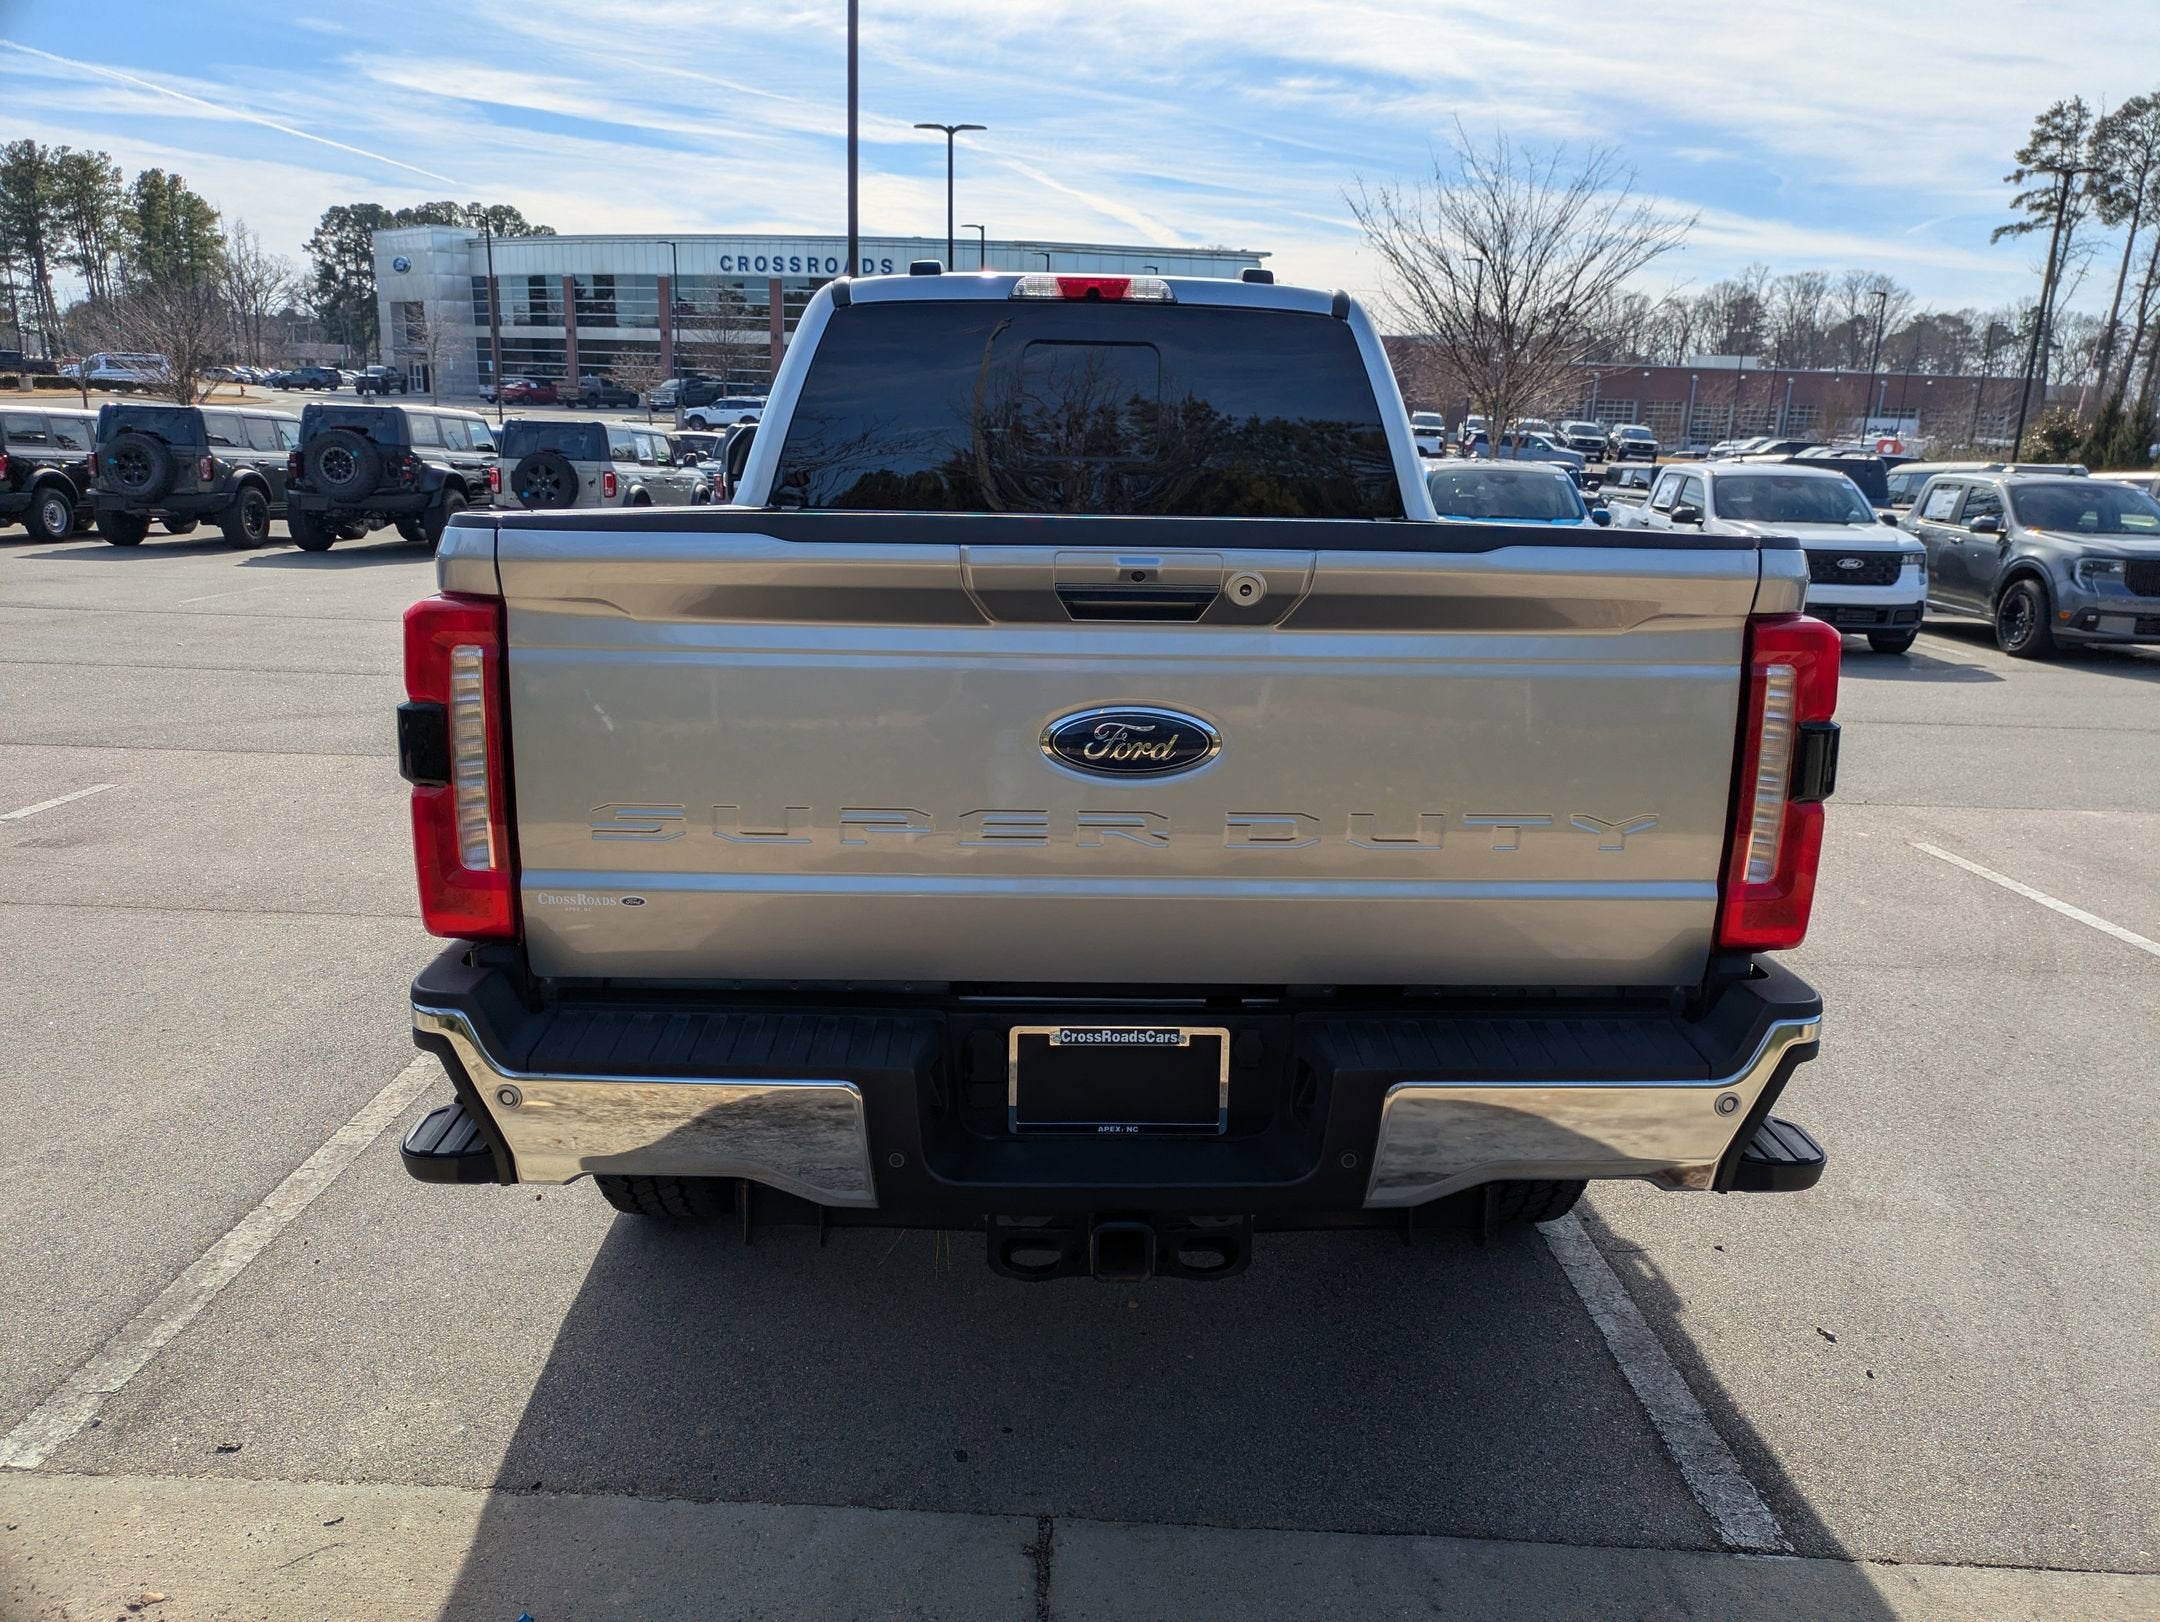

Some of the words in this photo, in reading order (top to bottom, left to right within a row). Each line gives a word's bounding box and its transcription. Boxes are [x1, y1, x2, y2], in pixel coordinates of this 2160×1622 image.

[720, 255, 893, 274] CROSSRODS
[1084, 722, 1179, 761] Ford
[591, 802, 1169, 848] SUPER
[1225, 811, 1660, 852] DUTY
[1061, 1030, 1178, 1043] CrossRoadsCars
